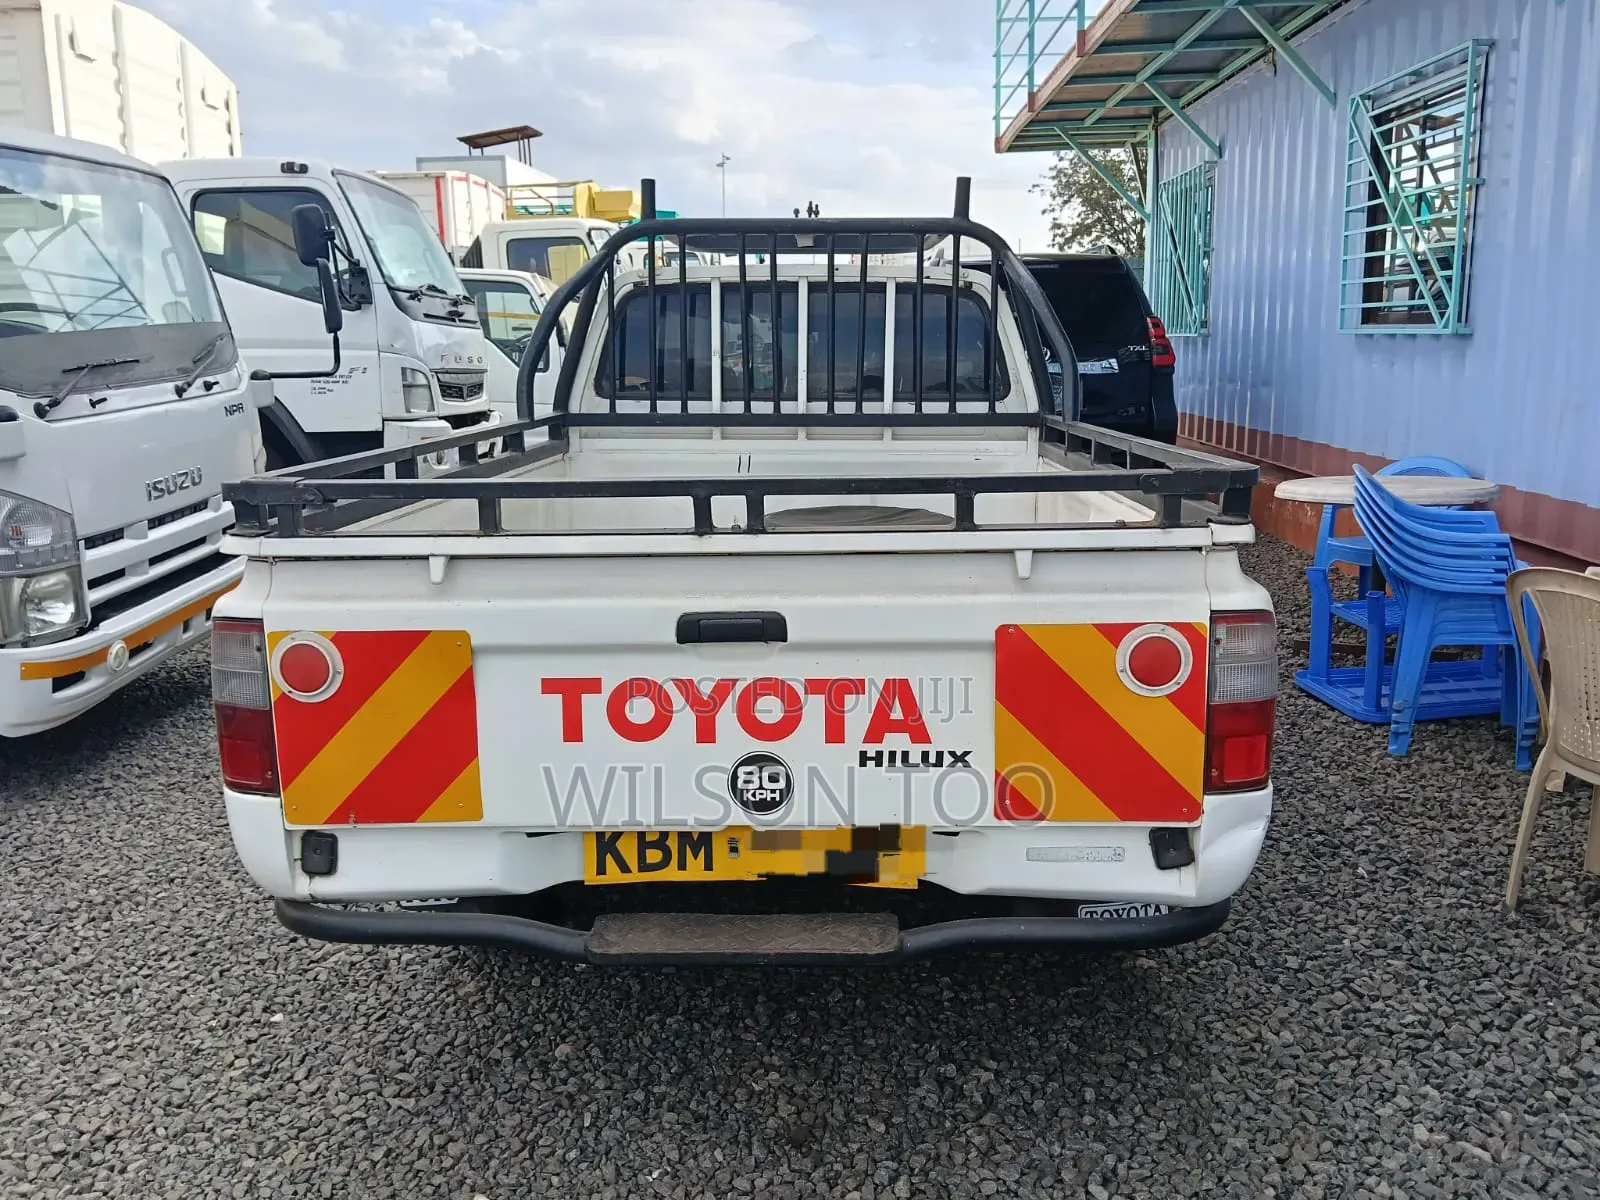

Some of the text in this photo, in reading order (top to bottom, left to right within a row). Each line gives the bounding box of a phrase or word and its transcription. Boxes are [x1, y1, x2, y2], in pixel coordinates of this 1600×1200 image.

[440, 353, 483, 364] FUSO
[224, 403, 245, 417] NPR
[145, 465, 203, 502] ISUZU
[541, 676, 932, 744] TOYOTA
[858, 750, 973, 768] HILUX
[736, 765, 787, 790] 80
[743, 790, 781, 802] KPH
[595, 831, 714, 876] KBM
